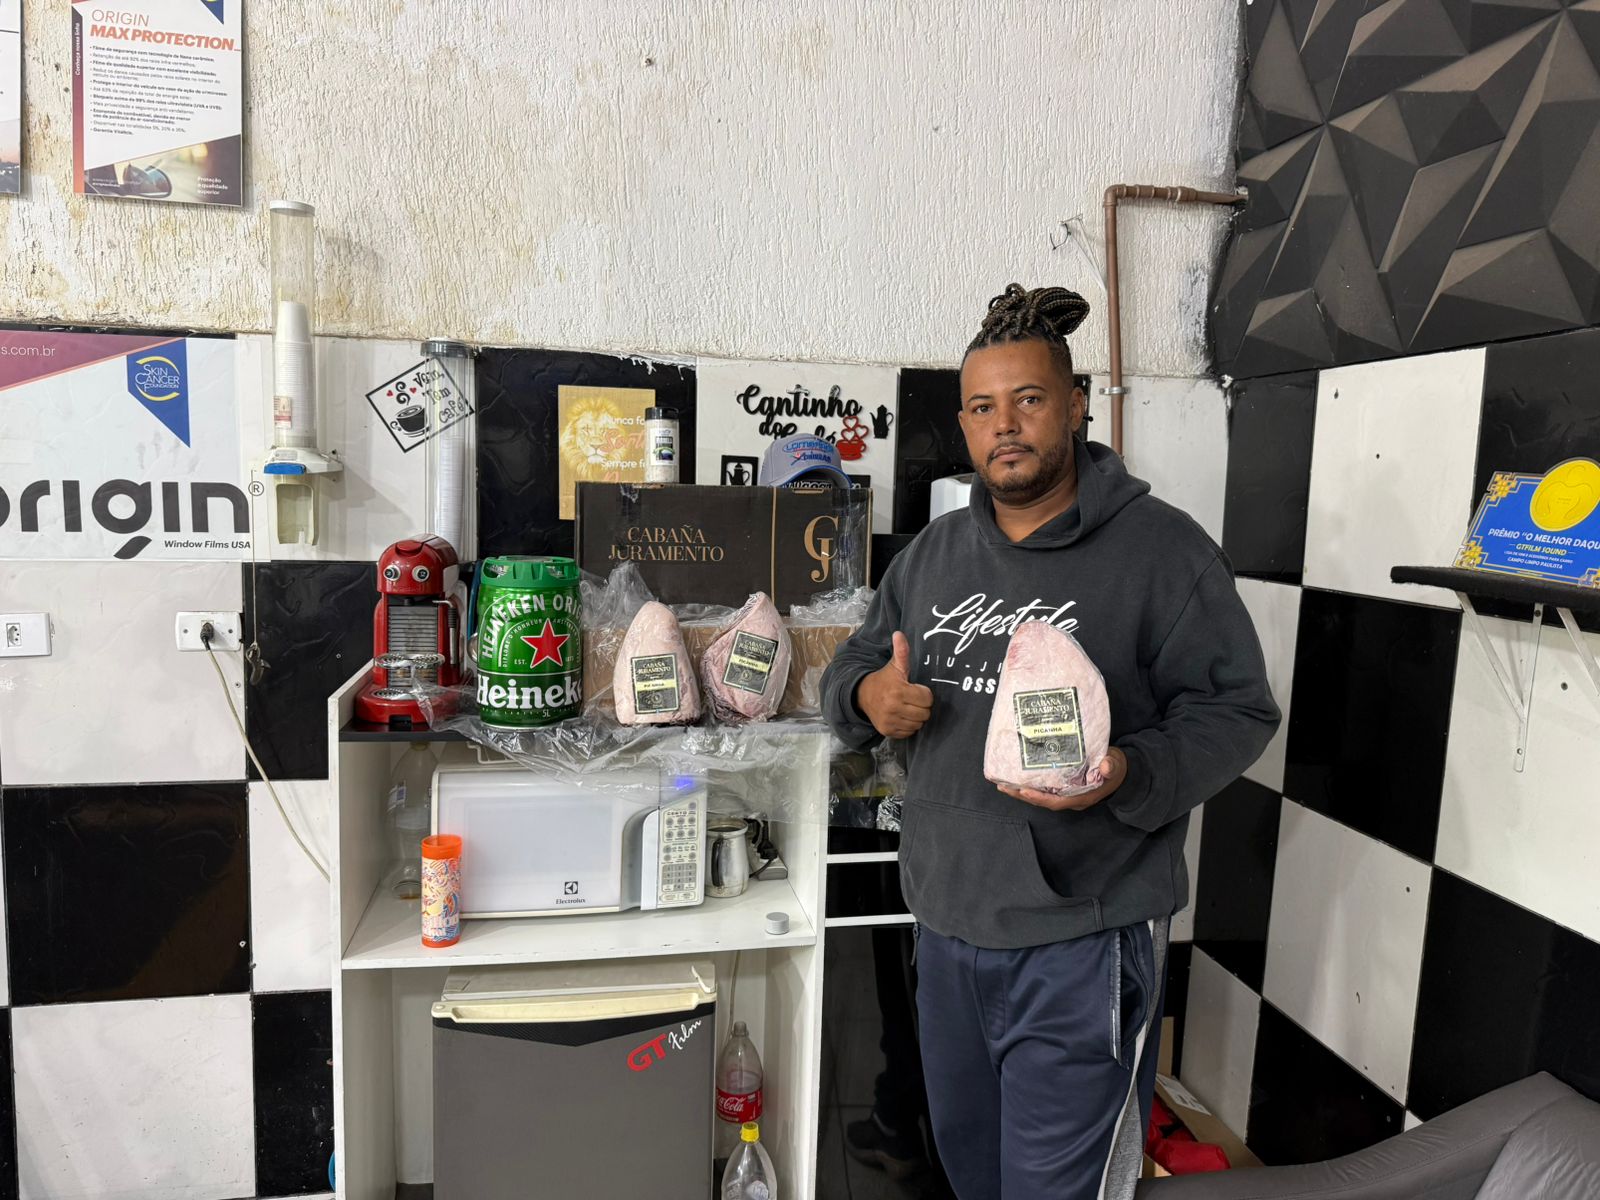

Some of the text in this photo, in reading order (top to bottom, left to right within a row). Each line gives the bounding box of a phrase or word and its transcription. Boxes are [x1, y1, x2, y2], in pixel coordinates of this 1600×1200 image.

[92, 9, 150, 27] ORIGIN
[90, 24, 235, 51] MAX PROTECTION
[135, 373, 180, 385] CANCER
[144, 364, 168, 376] SKIN
[736, 384, 863, 418] Cantinho
[0, 478, 250, 560] rigin
[627, 524, 707, 544] CABAÑA
[1488, 527, 1520, 539] PRÊMIO
[1534, 533, 1572, 546] MELHOR
[164, 540, 251, 550] Window Films USA
[608, 544, 724, 562] JURAMENTO
[1542, 546, 1567, 556] SOUND
[482, 594, 546, 659] HEINEKEN
[476, 674, 582, 709] Heinek
[1030, 697, 1061, 707] CABAÑA
[542, 709, 551, 718] 5L
[555, 896, 586, 905] Electrolux
[627, 1033, 667, 1072] GT
